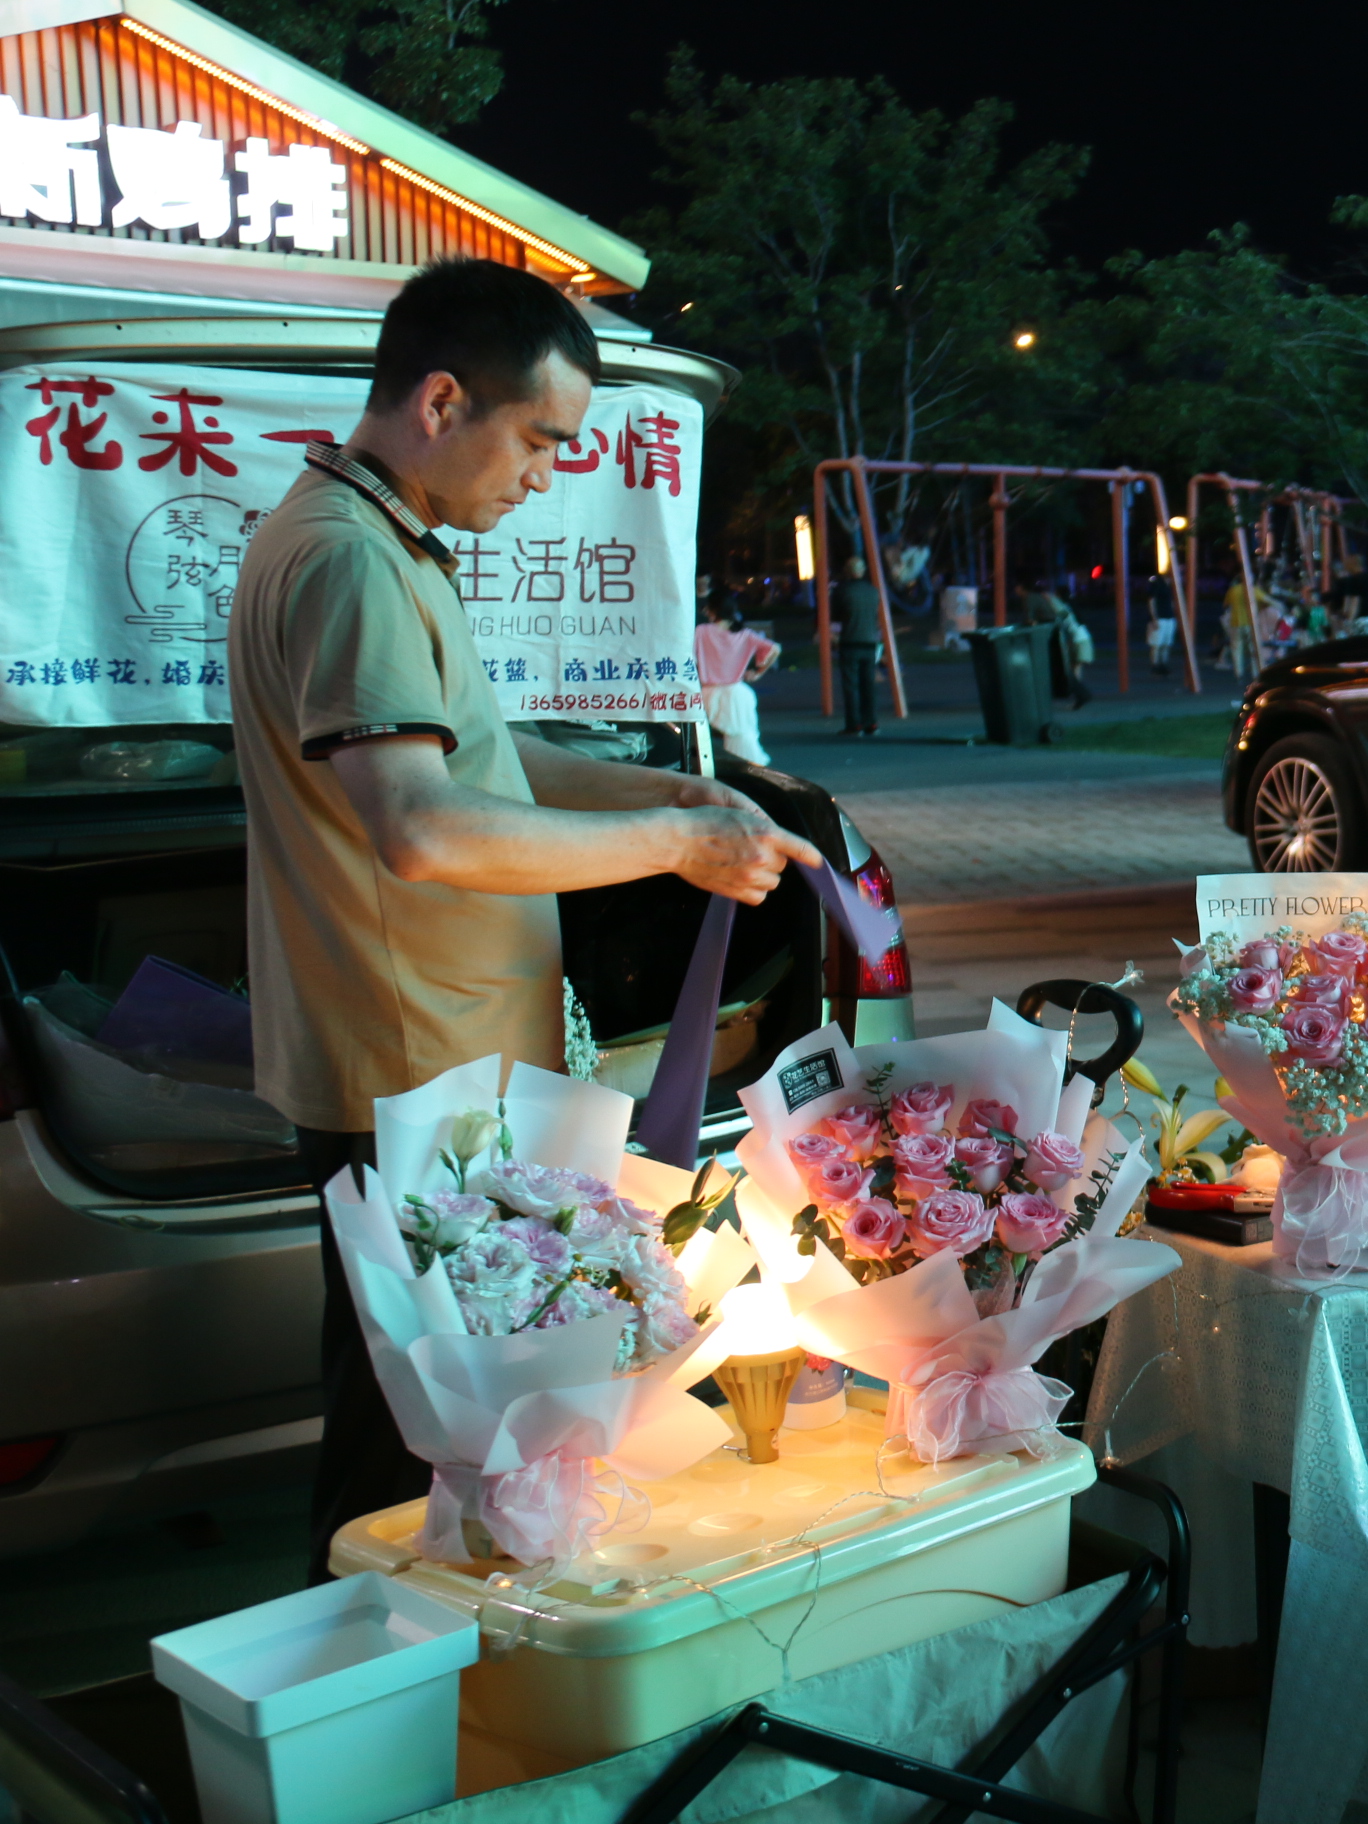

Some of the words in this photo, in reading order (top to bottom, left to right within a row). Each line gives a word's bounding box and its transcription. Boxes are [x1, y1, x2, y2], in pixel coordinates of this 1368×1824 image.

[453, 536, 637, 604] 生活馆
[560, 615, 636, 636] GUAN
[1208, 896, 1278, 918] PRETTY
